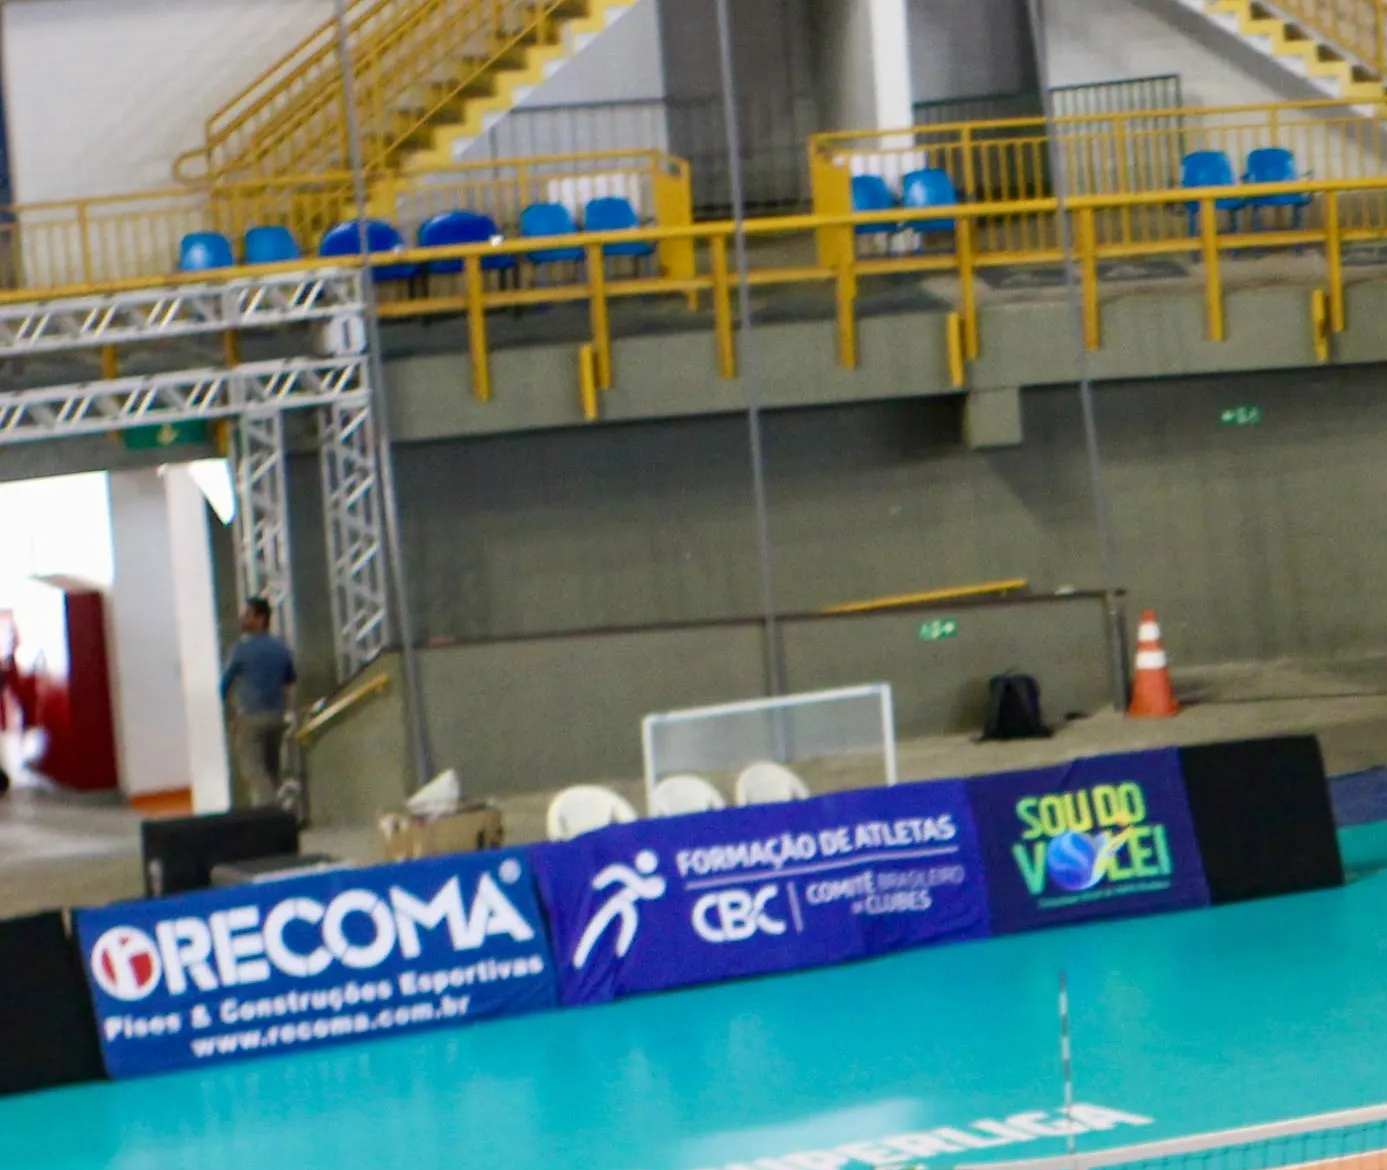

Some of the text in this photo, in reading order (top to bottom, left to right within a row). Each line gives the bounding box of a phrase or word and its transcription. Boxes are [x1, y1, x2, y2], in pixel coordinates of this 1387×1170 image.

[1015, 780, 1146, 841] SOU DO
[676, 814, 957, 877] FORMAÇÃO DE ATLETAS
[692, 884, 787, 943] CBC
[190, 994, 472, 1060] www.recoma.com.br
[191, 1002, 212, 1030] &
